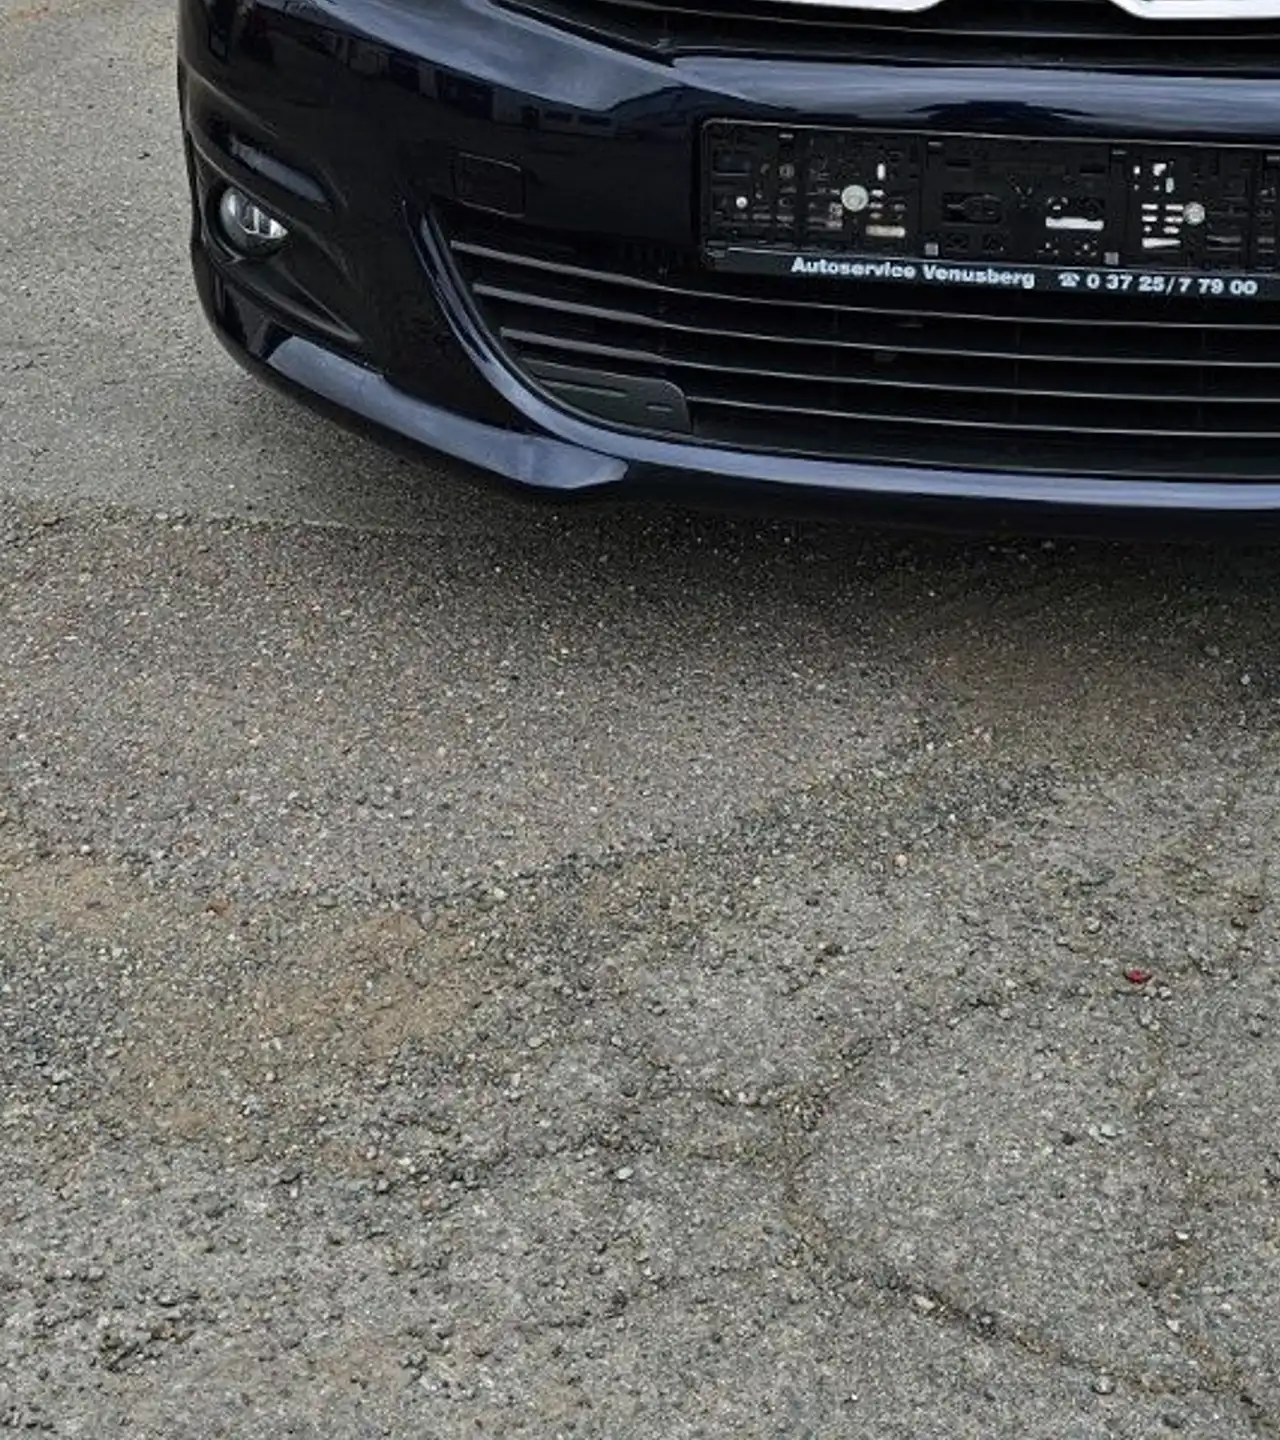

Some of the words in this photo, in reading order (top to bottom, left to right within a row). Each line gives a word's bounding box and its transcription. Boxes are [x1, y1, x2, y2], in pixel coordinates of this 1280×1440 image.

[791, 257, 917, 279] Autoservice
[922, 263, 1036, 289] Venusberg
[1086, 273, 1100, 289] 0
[1105, 274, 1133, 290] 37
[1197, 278, 1224, 294] 79
[1229, 279, 1258, 295] 00
